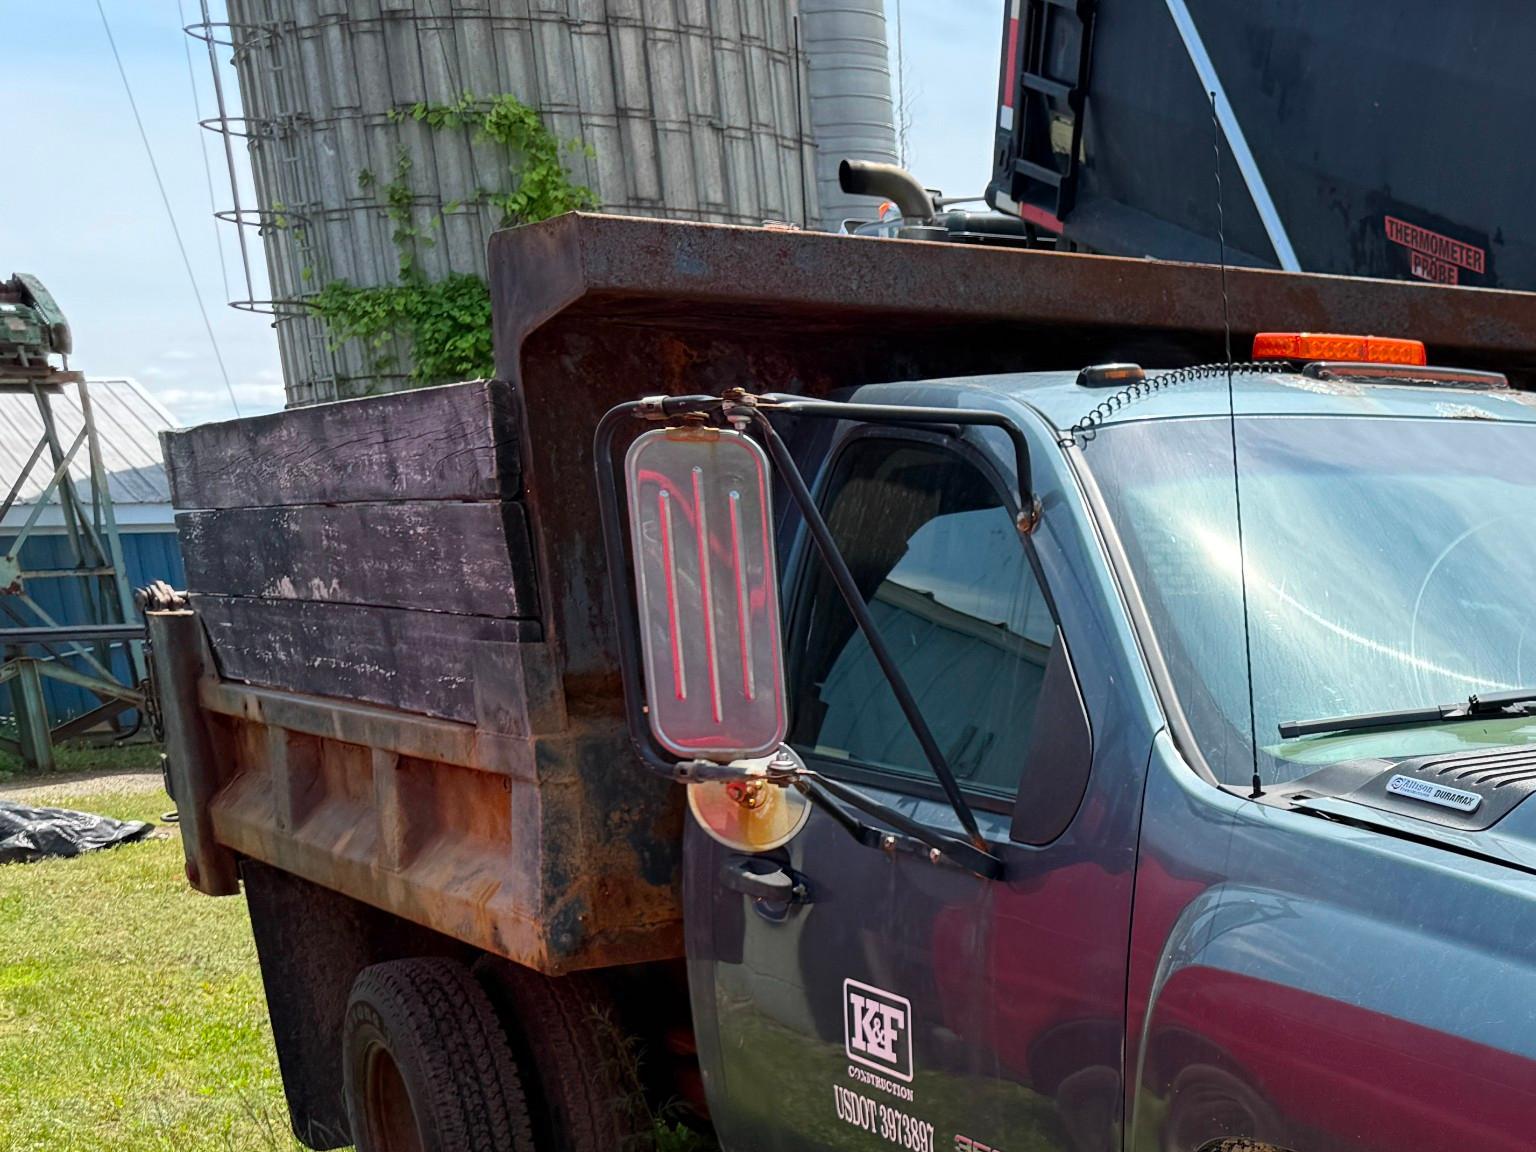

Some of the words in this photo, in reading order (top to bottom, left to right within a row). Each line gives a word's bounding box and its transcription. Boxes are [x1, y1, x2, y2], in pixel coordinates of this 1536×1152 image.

[1388, 219, 1483, 271] THERMOMETER
[1414, 253, 1456, 284] PROBE
[1433, 789, 1475, 807] DURAMAX
[850, 993, 904, 1063] K&F
[848, 1065, 914, 1102] CONSTRUCTION
[834, 1084, 877, 1134] USDOT
